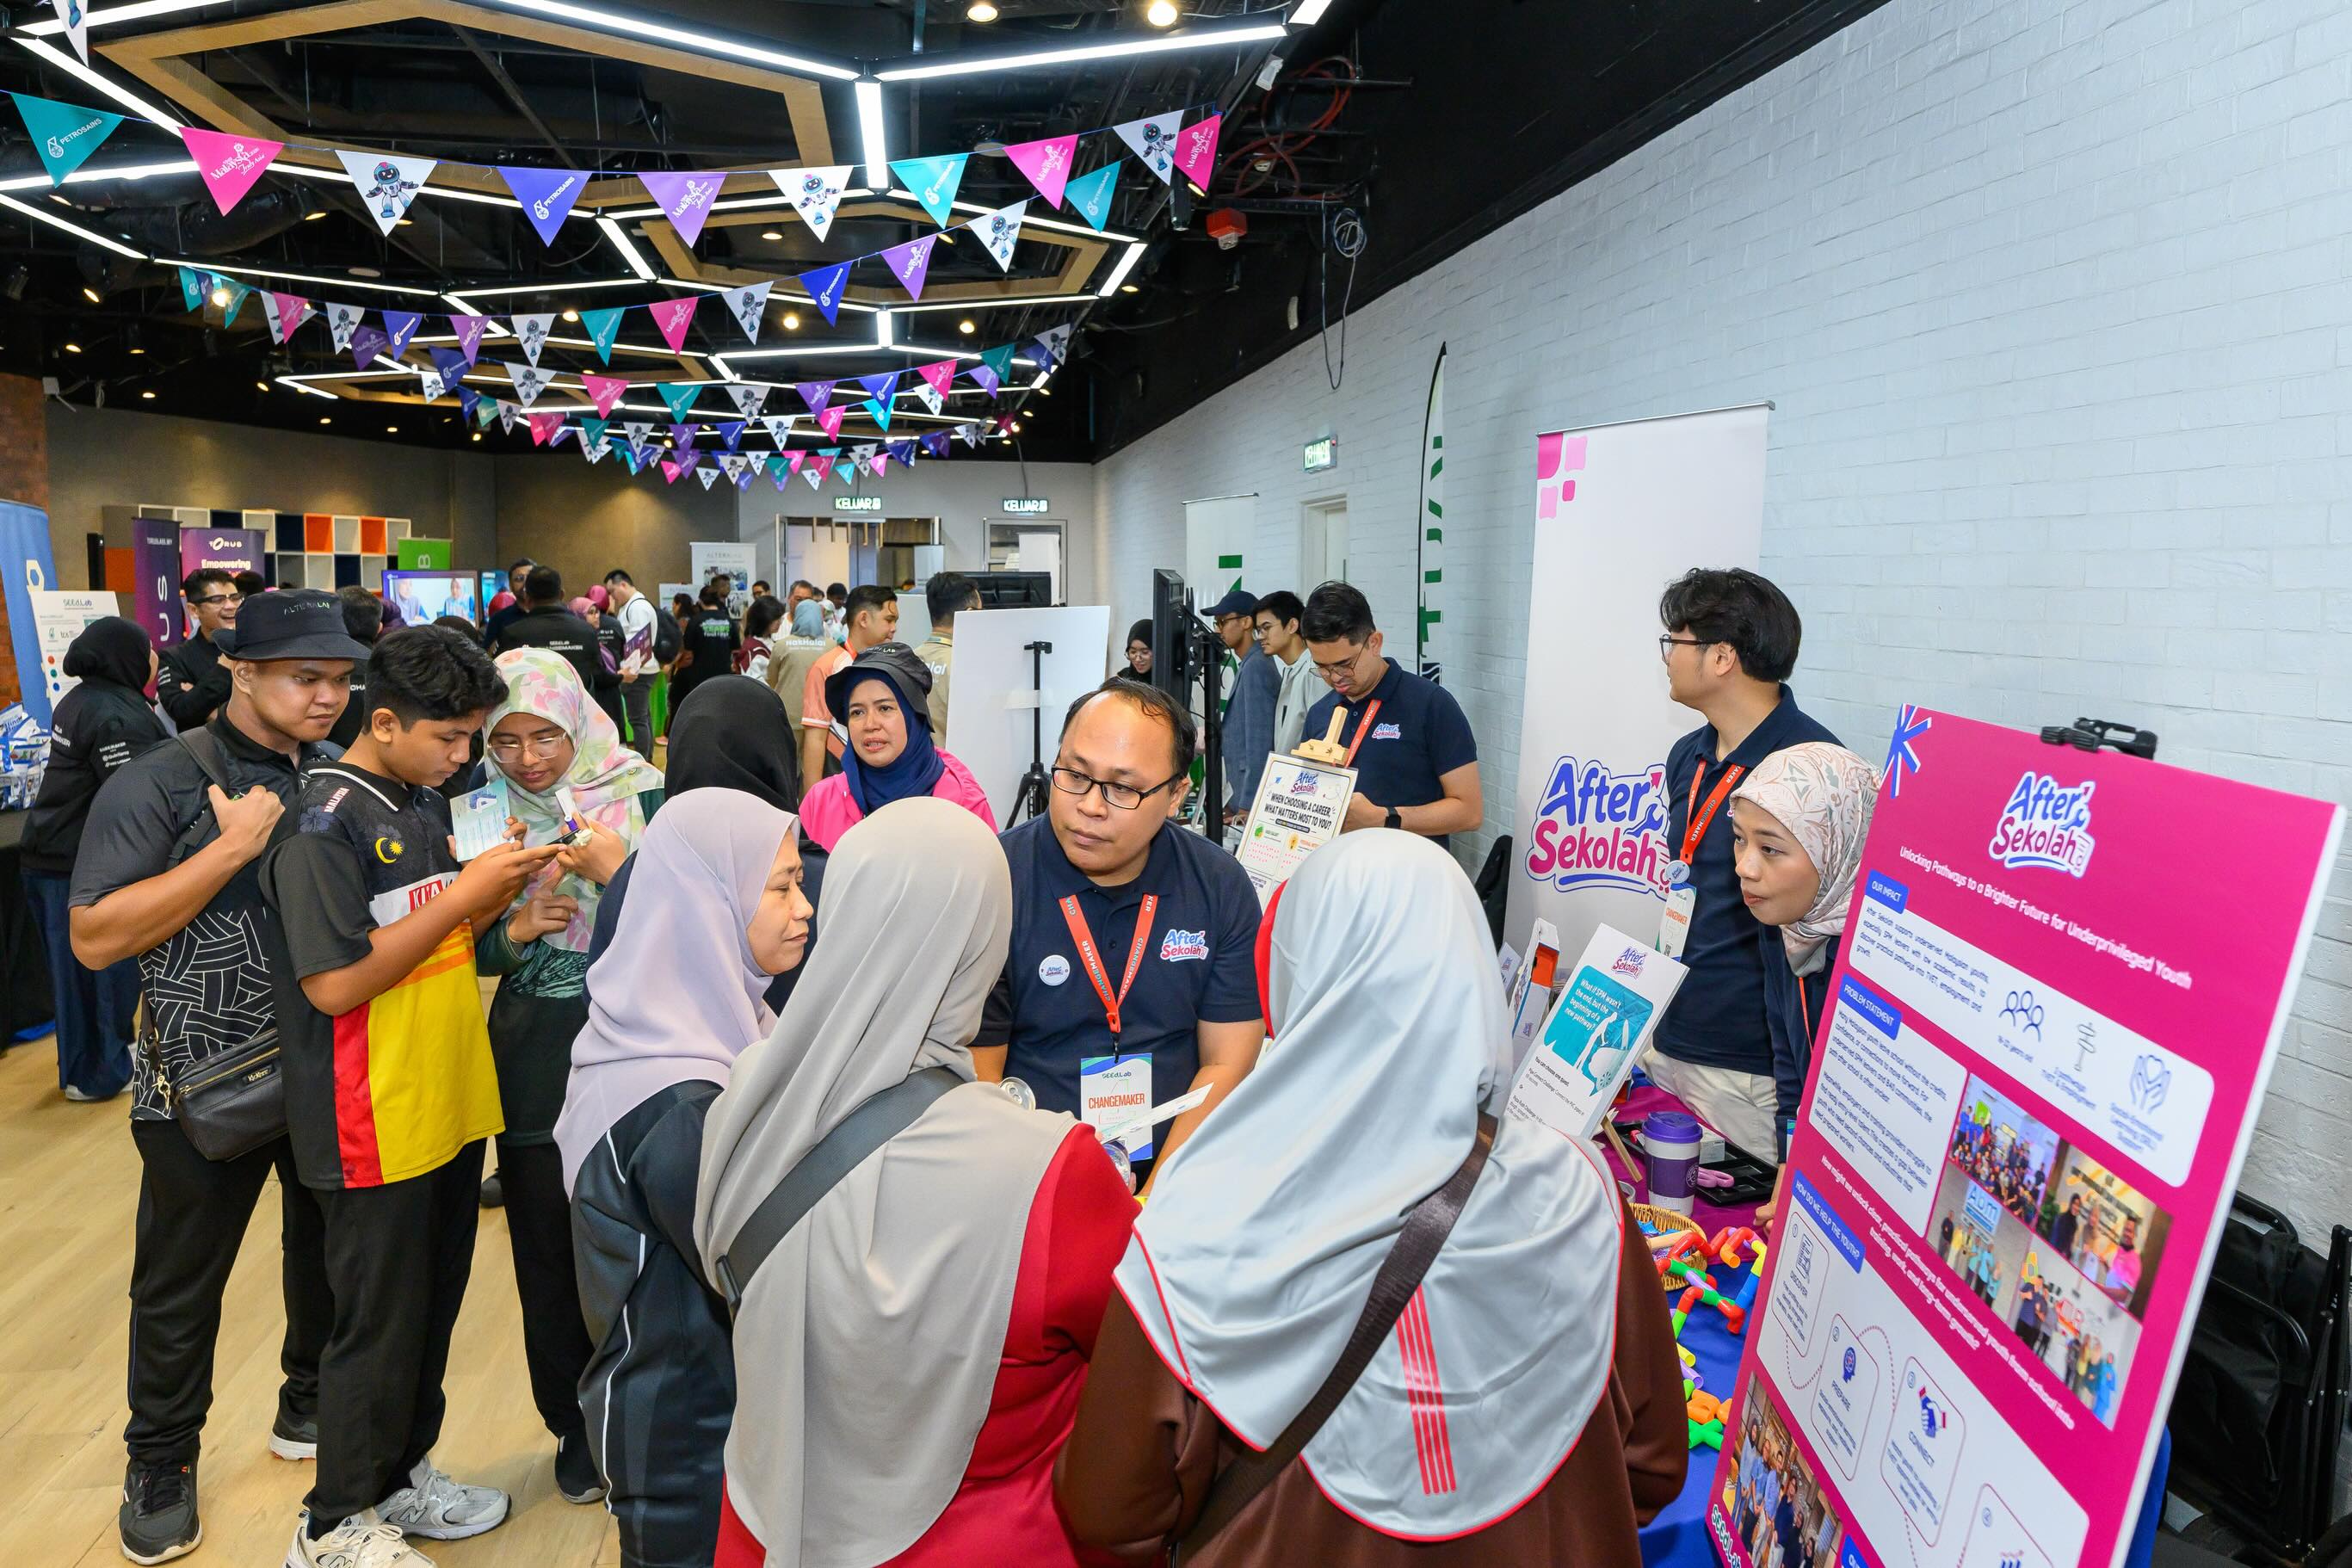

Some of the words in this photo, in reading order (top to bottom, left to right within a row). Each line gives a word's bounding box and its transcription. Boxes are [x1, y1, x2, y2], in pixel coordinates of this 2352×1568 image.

[59, 118, 102, 145] PETROSAINS
[210, 151, 251, 180] Malaysia
[544, 176, 575, 207] PETROSAINS
[836, 498, 874, 509] KELUAR
[1003, 499, 1040, 512] KELUAR
[201, 559, 251, 570] Empowering
[1377, 723, 1398, 732] After
[1295, 772, 1317, 784] After
[324, 787, 350, 813] MALAYSIA
[1270, 793, 1284, 803] WHEN
[1283, 796, 1307, 809] CHOOSING
[1312, 804, 1330, 817] CAREER,
[1540, 762, 1651, 826] After
[2007, 775, 2083, 821] After
[1264, 804, 1278, 813] WHAT
[1277, 807, 1298, 819] MATTERS
[1298, 812, 1312, 823] MOST
[1311, 817, 1318, 825] TO
[1318, 818, 1331, 829] YOU?
[1528, 819, 1658, 885] Sekolah
[1992, 816, 2077, 866] Sekolah
[1871, 880, 1883, 892] OUR
[1882, 886, 1900, 901] IMPACT
[1899, 846, 1931, 872] Unlocking
[1931, 861, 1966, 886] Pathways
[1966, 877, 1976, 890] to
[1976, 883, 1984, 893] a
[1984, 884, 2018, 909] Brighter
[2019, 899, 2049, 923] Future
[2050, 913, 2066, 930] for
[2067, 923, 2153, 972] Underprivileged
[2155, 960, 2191, 989] Youth
[1164, 930, 1201, 946] After
[1162, 945, 1202, 959] Sekolah
[1620, 948, 1643, 963] After
[1082, 940, 1111, 1002] CHANGEMAKER
[1613, 959, 1639, 976] Sekolah
[1570, 997, 1591, 1016] beginning
[1575, 988, 1583, 997] the
[1591, 999, 1601, 1008] but
[1599, 1003, 1608, 1014] the
[1580, 978, 1593, 991] What
[1595, 988, 1607, 999] SPM
[1605, 995, 1620, 1009] wasn't
[1844, 985, 1865, 1005] PROBLEM
[1865, 1000, 1893, 1025] STATEMENT
[1565, 1007, 1574, 1016] new
[1572, 1013, 1595, 1030] pathway?
[1089, 1093, 1145, 1109] CHANGEMAKER
[1795, 1180, 1806, 1196] HOW
[1806, 1191, 1812, 1205] DO
[1812, 1200, 1820, 1213] WE
[1819, 1208, 1831, 1225] HELP
[1831, 1221, 1841, 1238] THE
[1840, 1232, 1859, 1259] YOUTH?
[1790, 1270, 1807, 1297] DISCOVER
[1821, 1155, 1831, 1170] How
[1830, 1166, 1845, 1185] might
[1844, 1181, 1852, 1193] we
[1851, 1188, 1868, 1210] unlock
[1881, 1221, 1907, 1251] practical
[1905, 1247, 1935, 1283] pathways
[1935, 1276, 1946, 1293] for
[1985, 1332, 2009, 1361] youth
[2008, 1354, 2028, 1381] from
[2027, 1375, 2057, 1411] school
[2054, 1403, 2074, 1429] into
[1831, 1380, 1850, 1411] PREPARE
